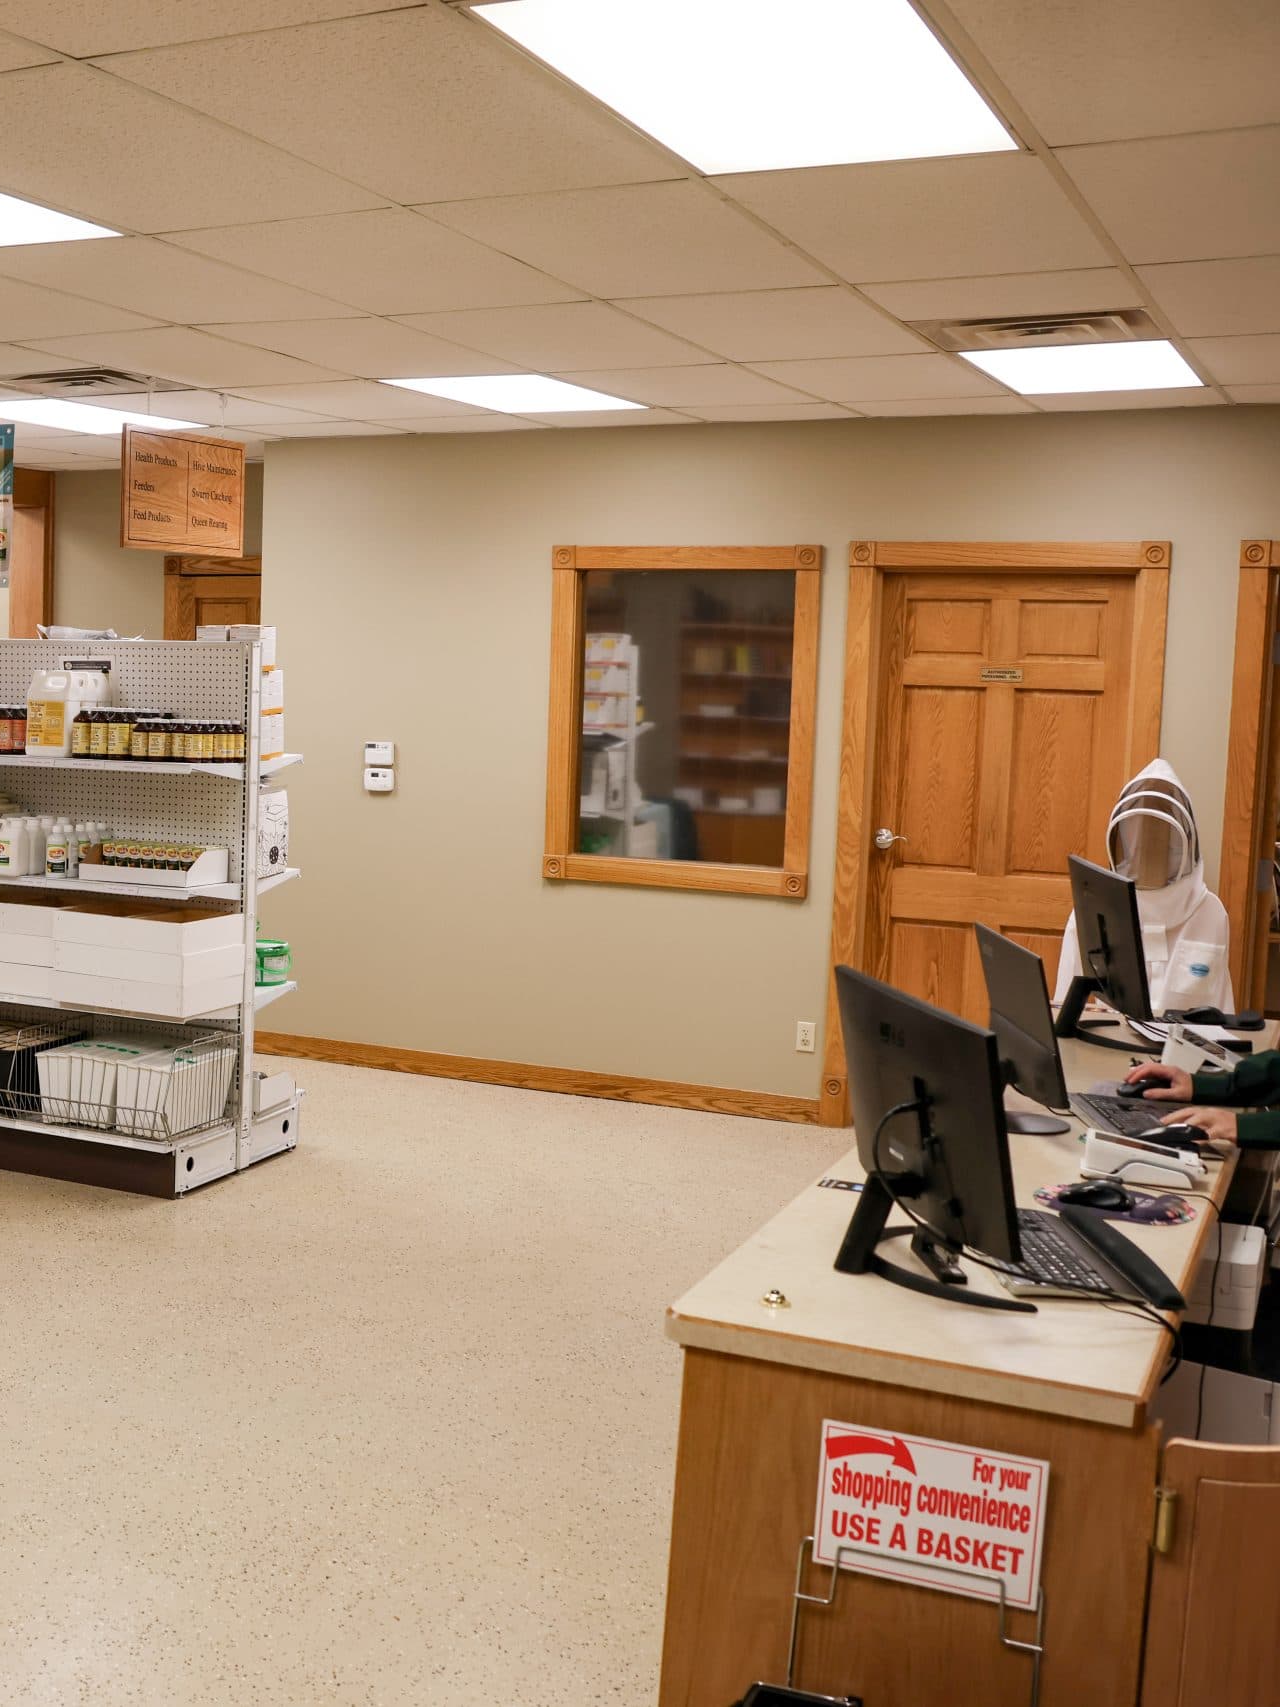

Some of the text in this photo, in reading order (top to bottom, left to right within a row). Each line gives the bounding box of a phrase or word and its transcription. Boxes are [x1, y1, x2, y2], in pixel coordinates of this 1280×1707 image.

[135, 451, 178, 467] Health Products
[192, 460, 237, 476] Hive Maintenance
[133, 480, 155, 492] Feeders
[191, 487, 233, 504] Swarm Catching
[133, 509, 172, 523] Feed Products
[191, 516, 228, 531] Queen Rearing
[972, 1456, 1032, 1491] For your
[831, 1461, 1031, 1534] shopping convenience
[831, 1509, 1025, 1576] USE A BASKET
